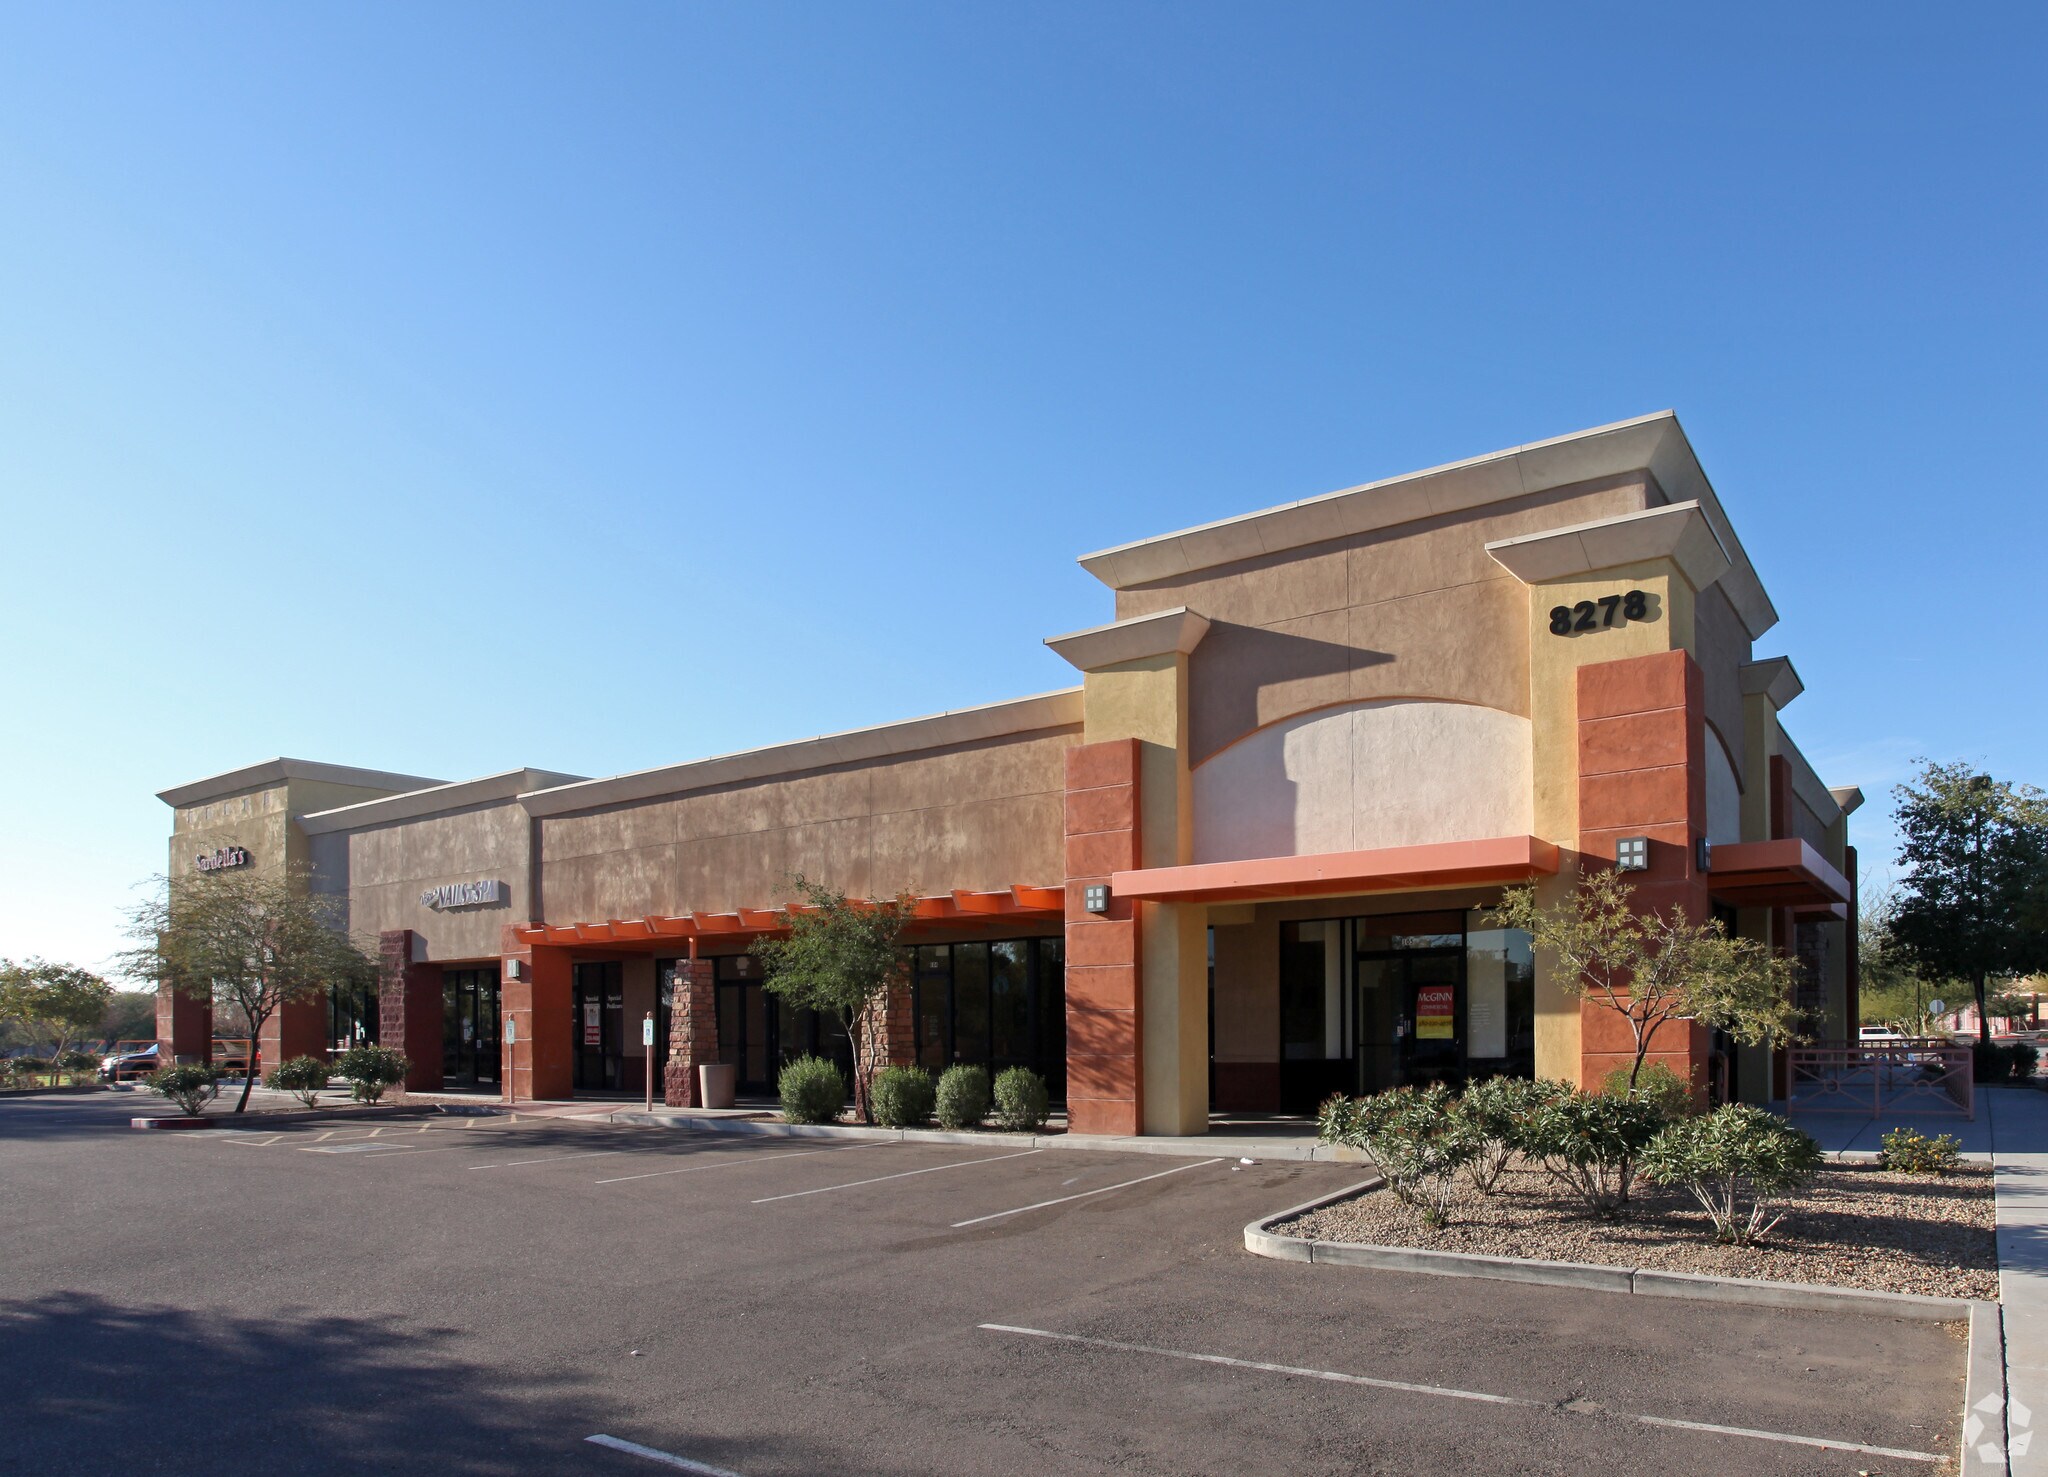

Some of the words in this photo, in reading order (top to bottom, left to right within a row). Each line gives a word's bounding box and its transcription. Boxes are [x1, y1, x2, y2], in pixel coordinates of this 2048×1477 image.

[1549, 590, 1646, 636] 8278
[438, 884, 468, 907] NAILS
[475, 879, 499, 904] SPA
[1418, 992, 1453, 1002] McGINN
